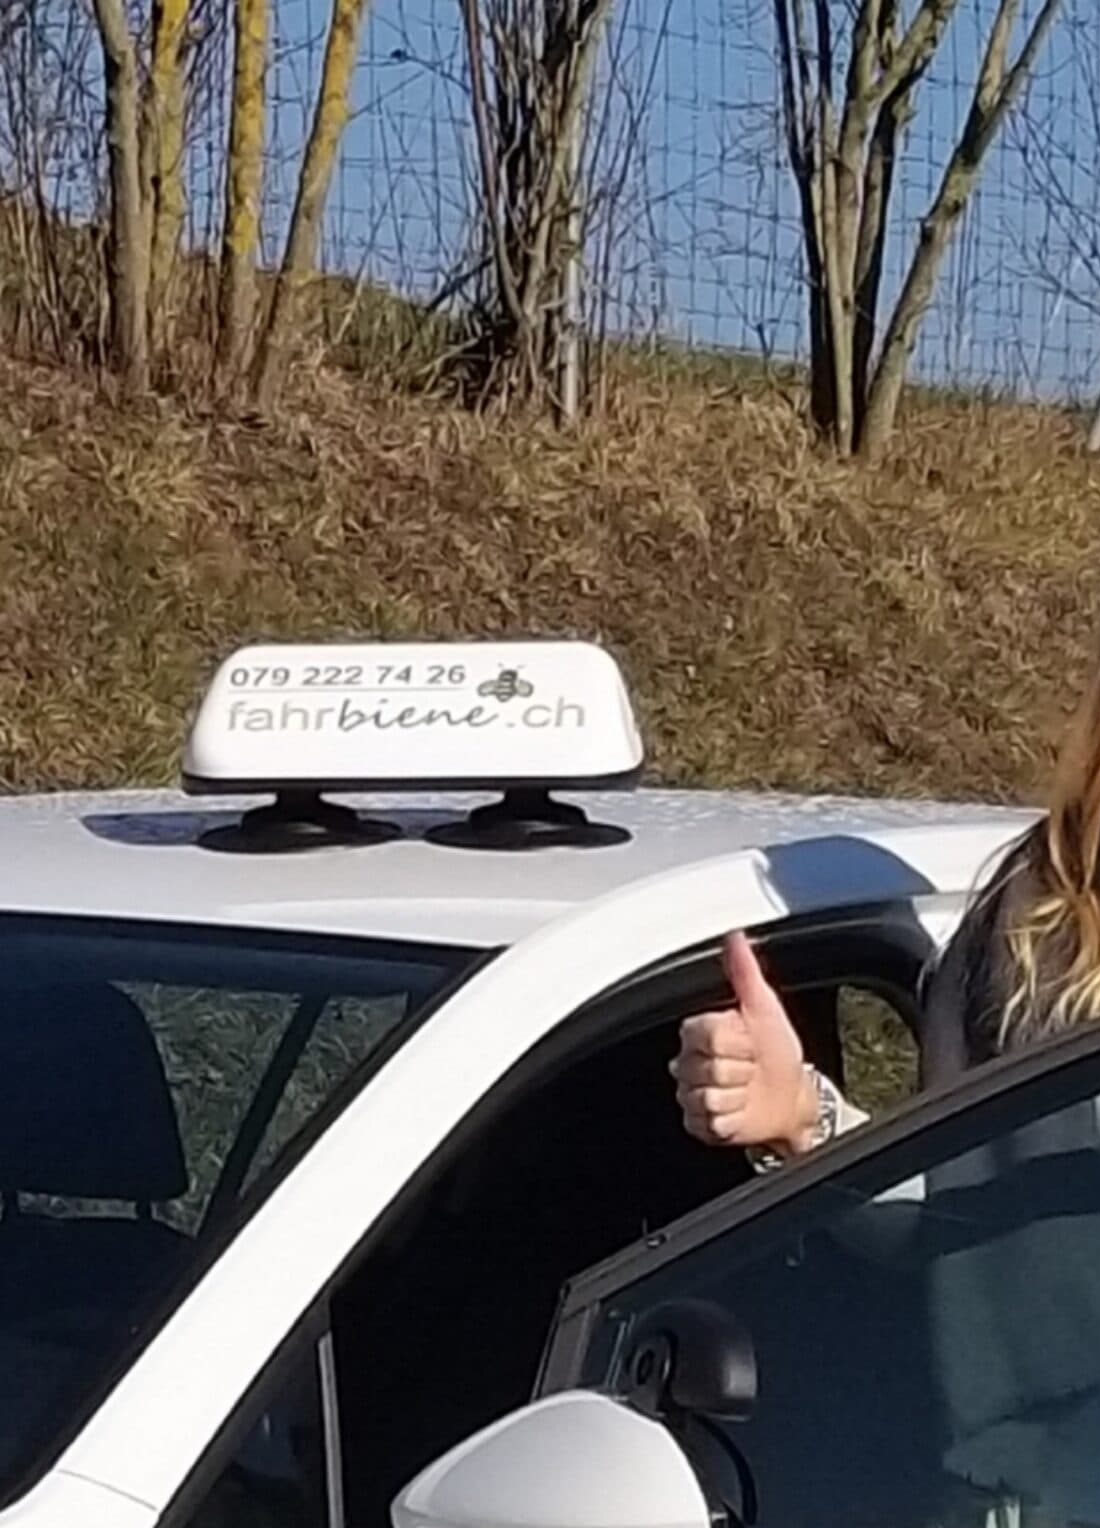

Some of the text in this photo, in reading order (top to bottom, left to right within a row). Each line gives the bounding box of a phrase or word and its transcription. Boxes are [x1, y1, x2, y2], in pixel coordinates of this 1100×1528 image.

[230, 664, 466, 687] 079 222 74 26
[227, 697, 586, 733] fahrbiene.ch
